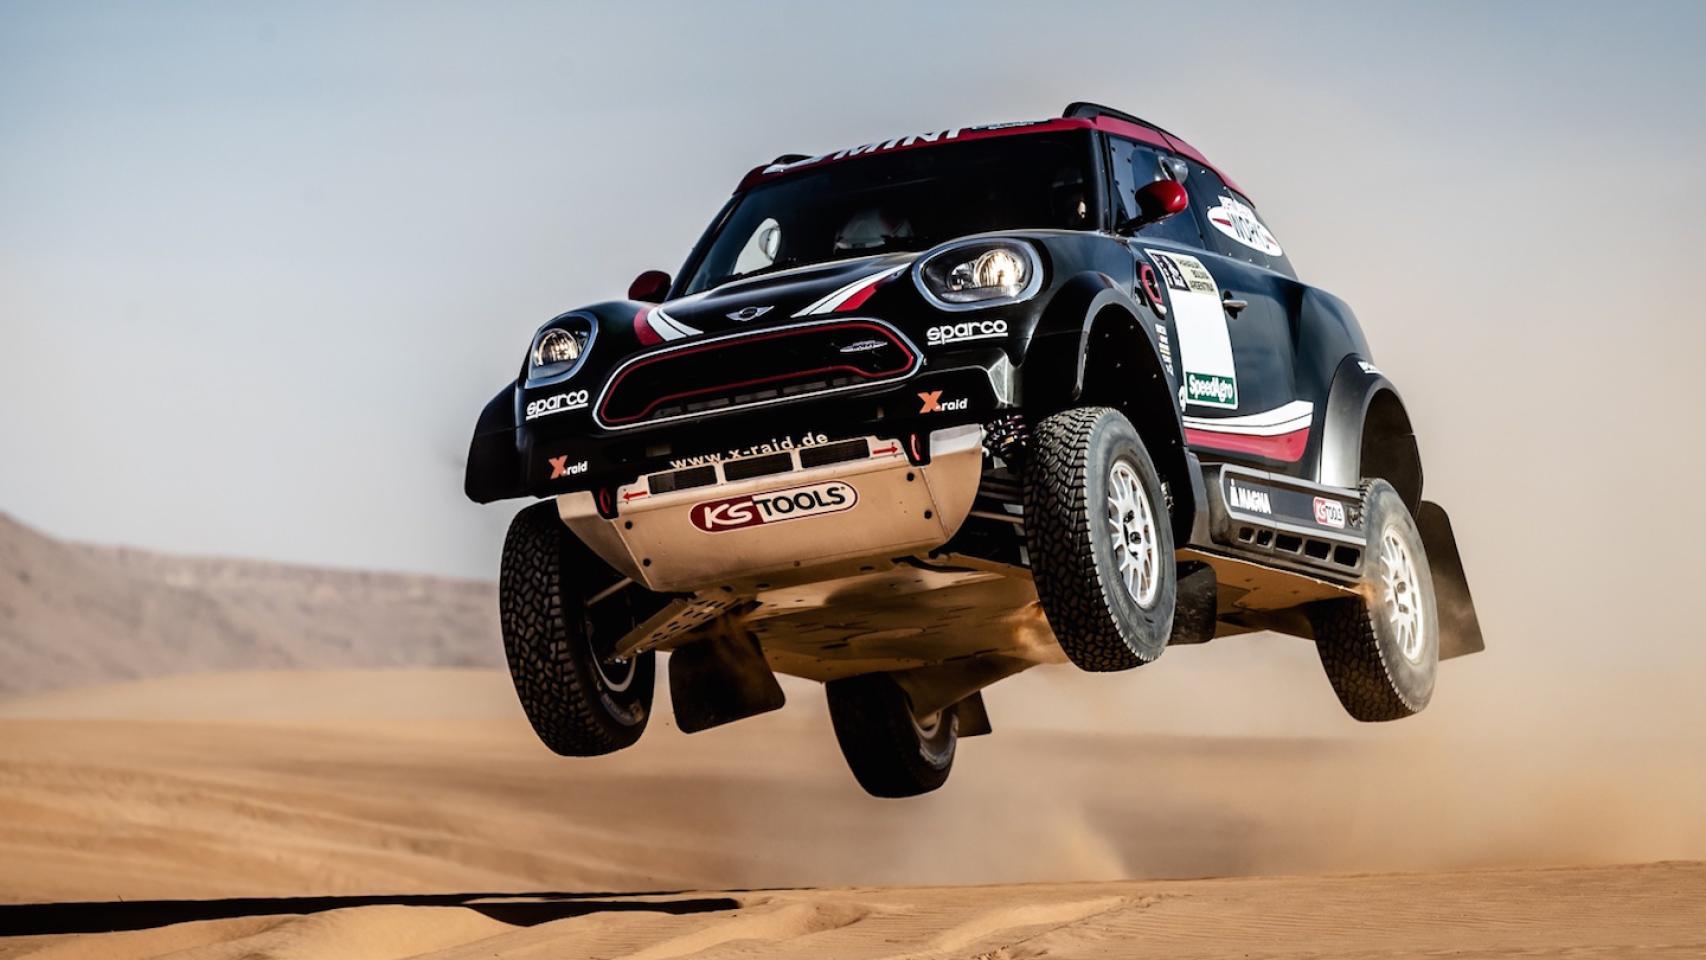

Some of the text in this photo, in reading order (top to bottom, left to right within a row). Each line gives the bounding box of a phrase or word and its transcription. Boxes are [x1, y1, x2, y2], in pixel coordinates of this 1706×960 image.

[926, 319, 1008, 345] sparco
[1189, 374, 1233, 402] SpeedAgro
[526, 389, 589, 420] sparco
[669, 431, 829, 469] www.x-raid.de
[1238, 487, 1271, 513] MAGNA
